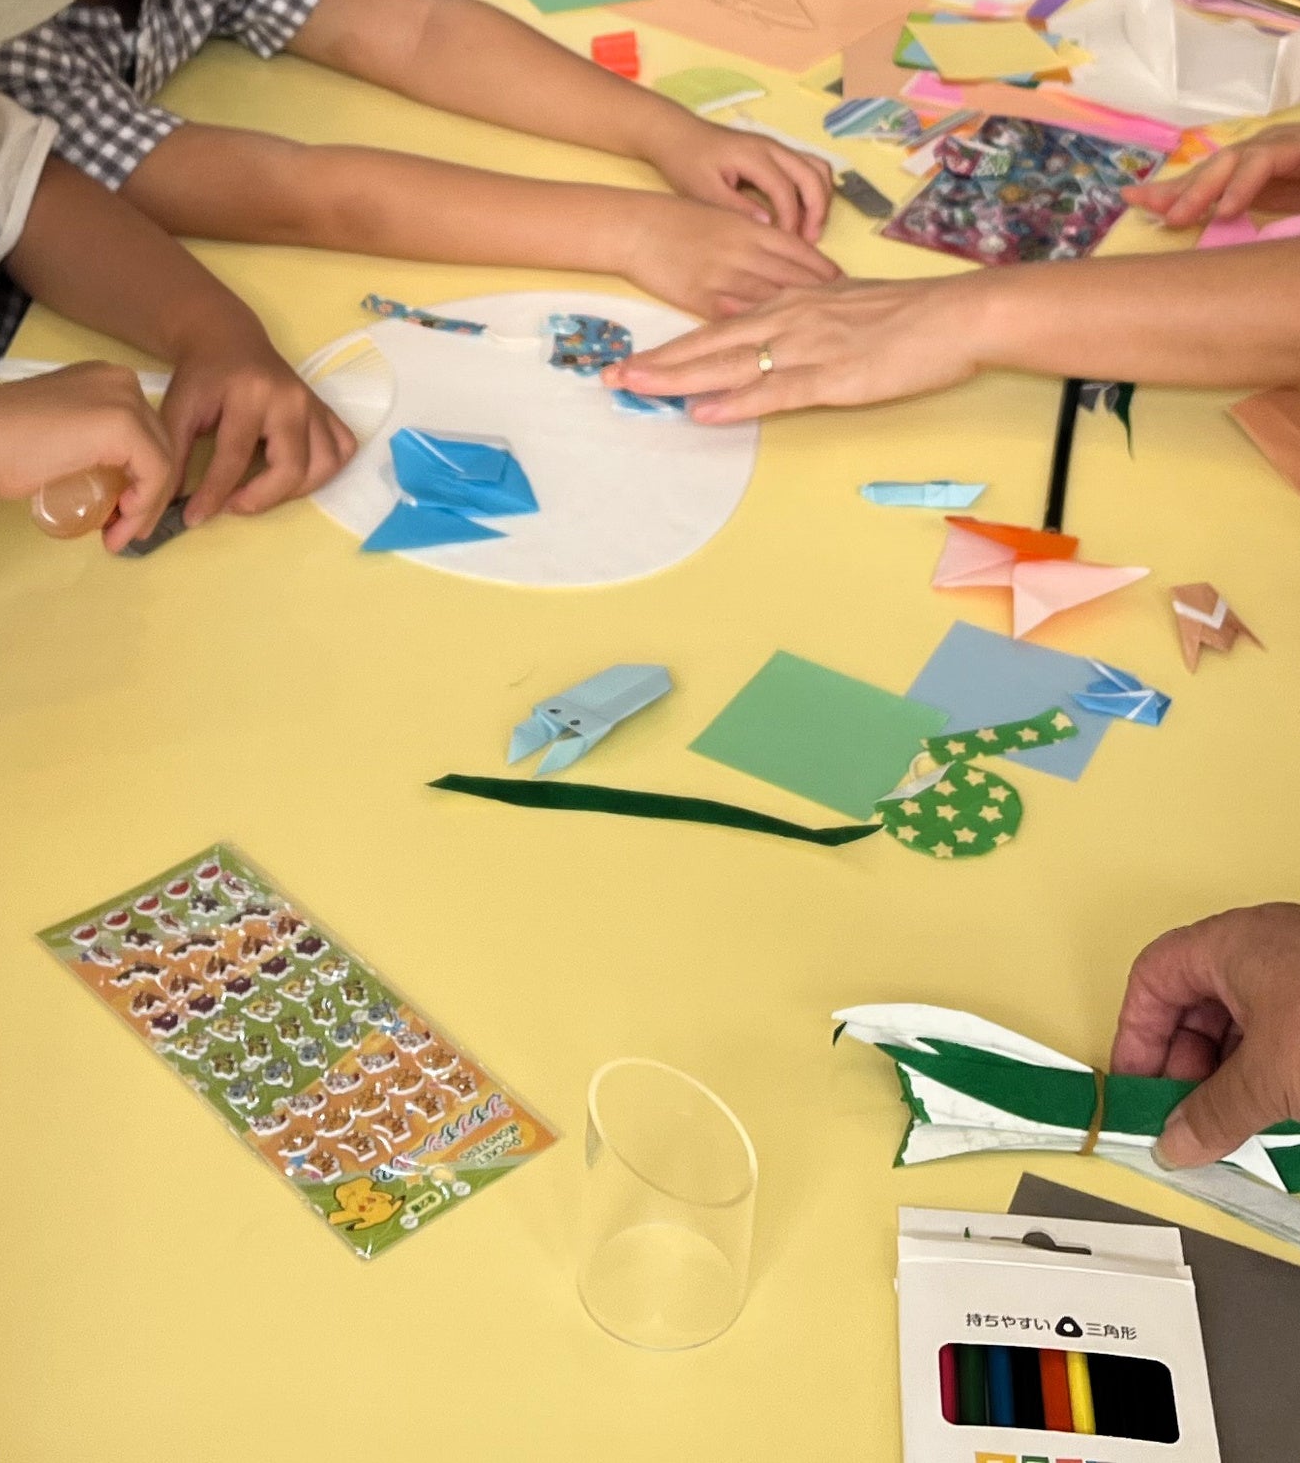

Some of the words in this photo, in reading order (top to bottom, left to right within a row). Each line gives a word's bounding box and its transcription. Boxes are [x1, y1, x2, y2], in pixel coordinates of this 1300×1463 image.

[459, 1121, 520, 1163] MONSTERS
[477, 1134, 522, 1166] POCKET
[965, 1312, 1051, 1332] 持ちやすい
[1085, 1320, 1138, 1340] 三角形
